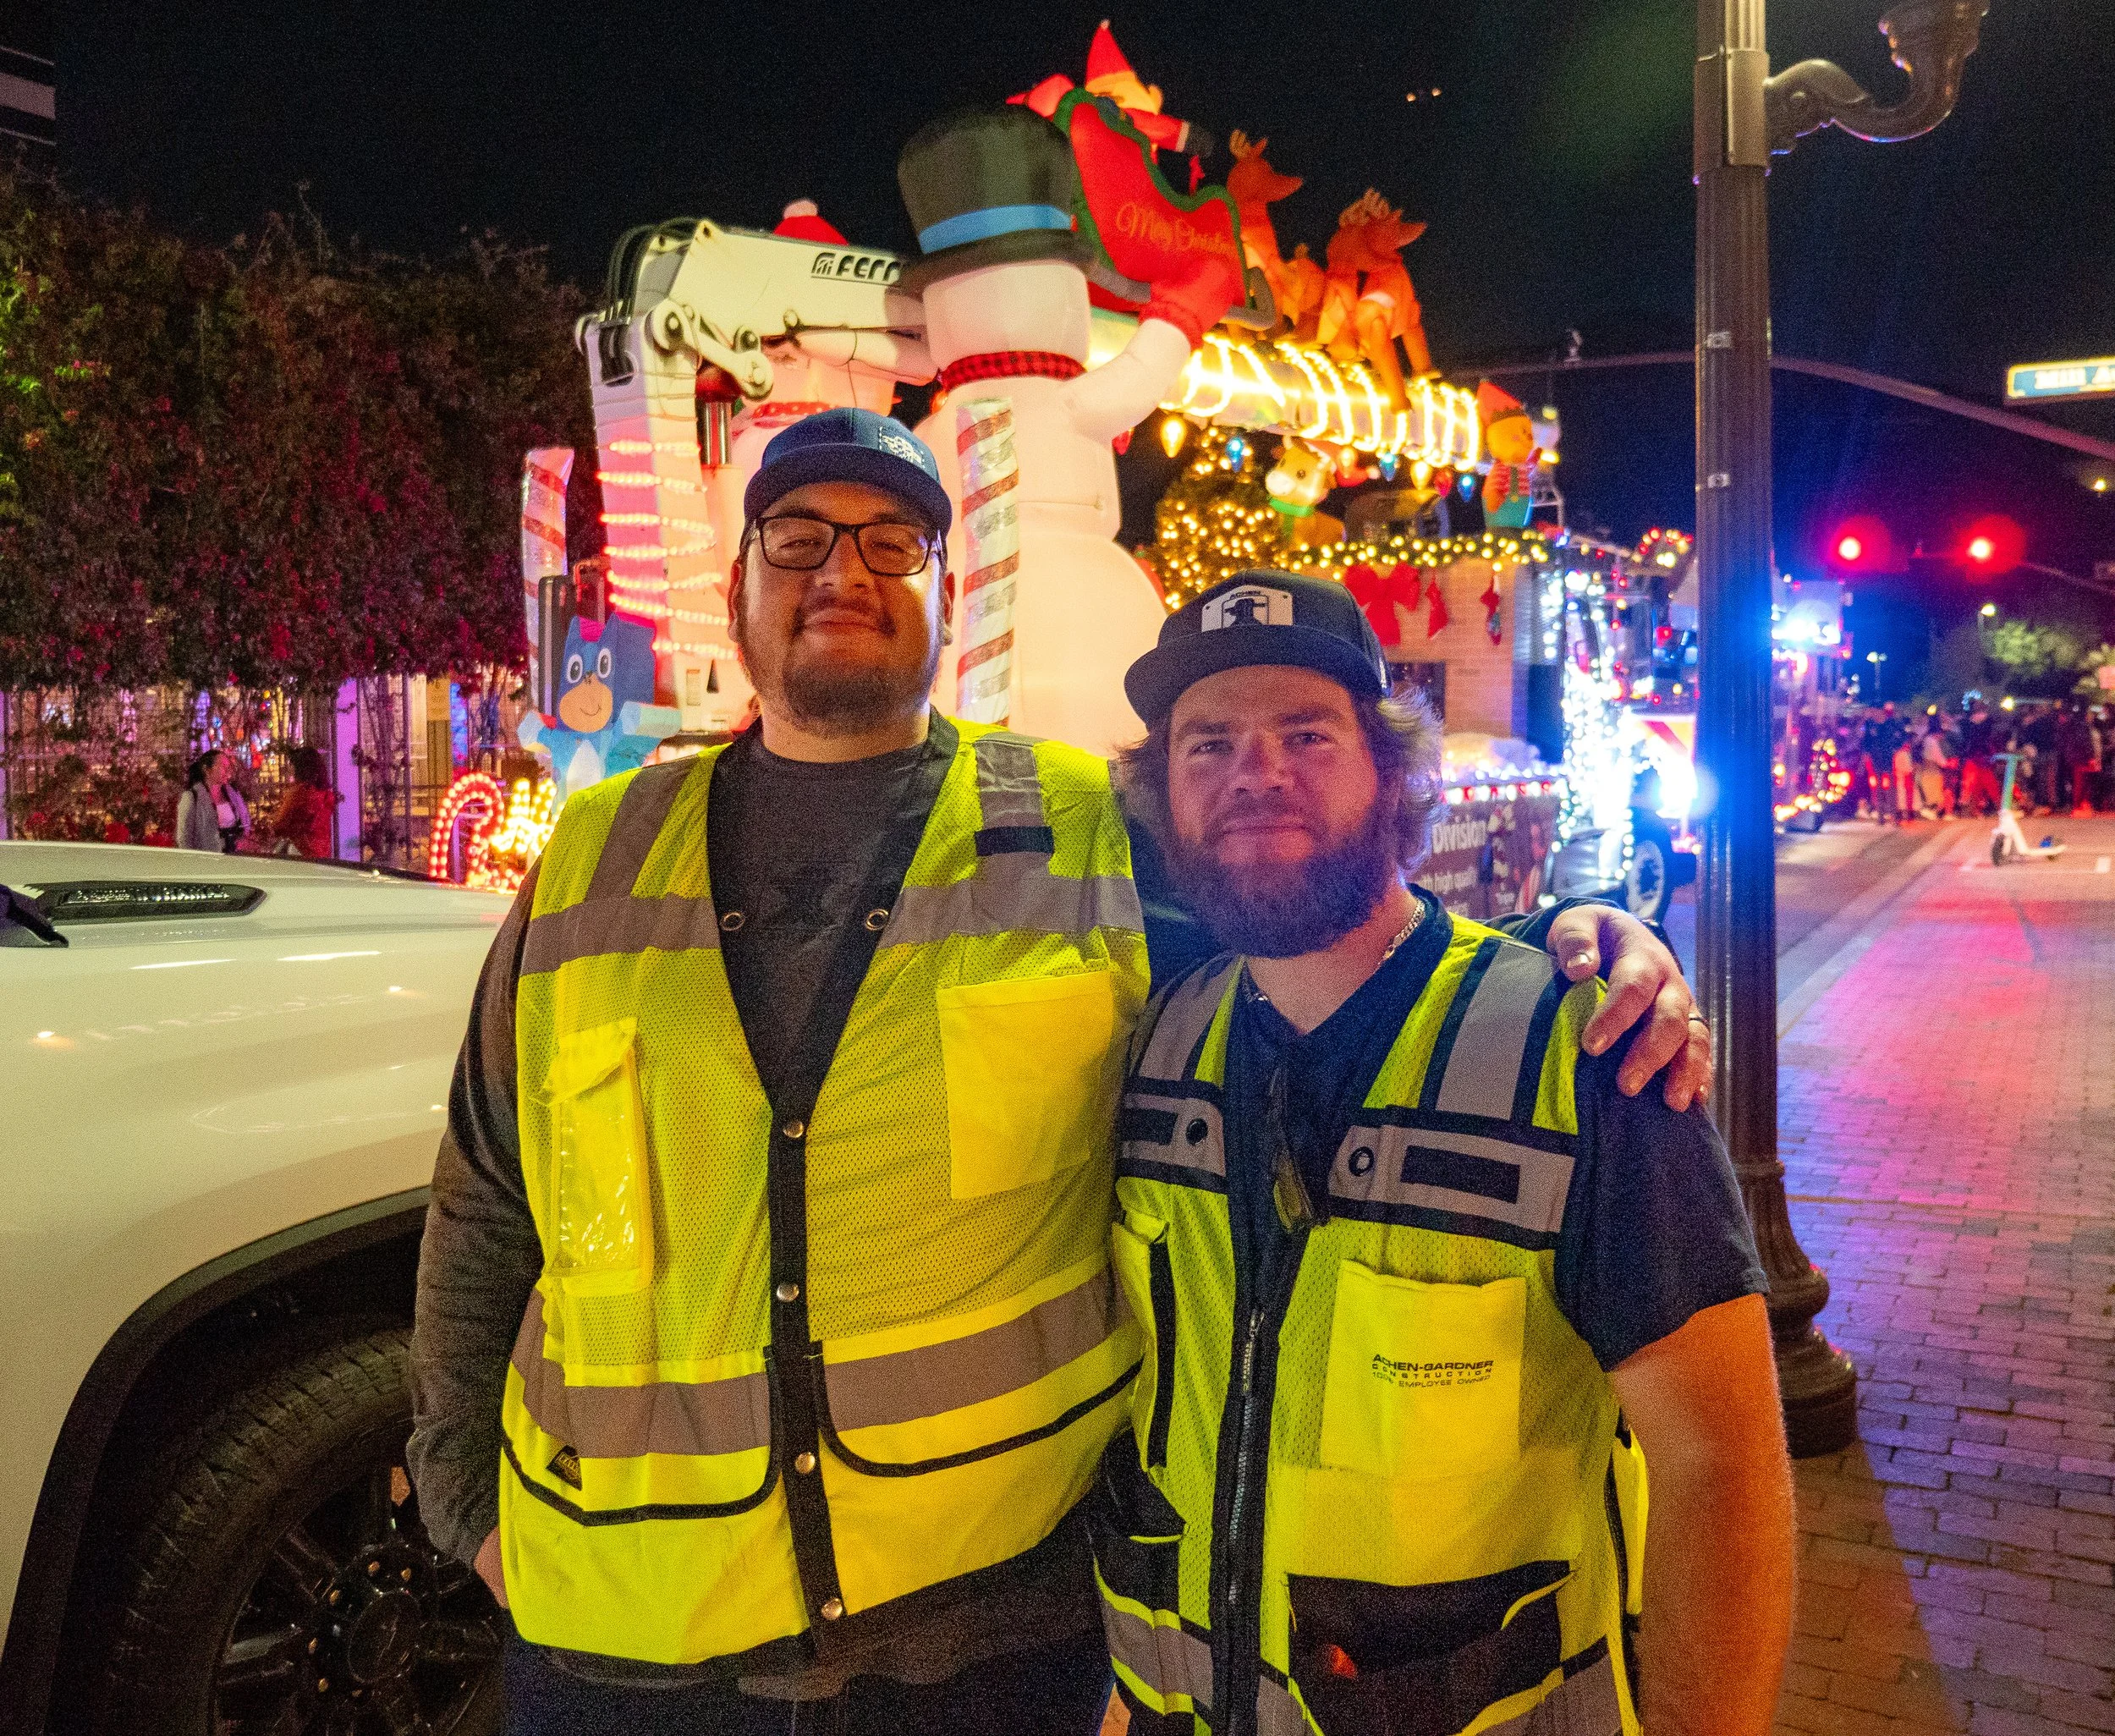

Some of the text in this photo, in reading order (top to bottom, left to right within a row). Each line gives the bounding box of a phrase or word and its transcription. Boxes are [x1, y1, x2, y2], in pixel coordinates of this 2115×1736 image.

[1373, 1354, 1494, 1371] ACHEN-GARDNER
[1372, 1363, 1492, 1379] CONSTRUCTION
[1398, 1379, 1452, 1388] EMPLOYEE
[1456, 1374, 1491, 1385] OWNED
